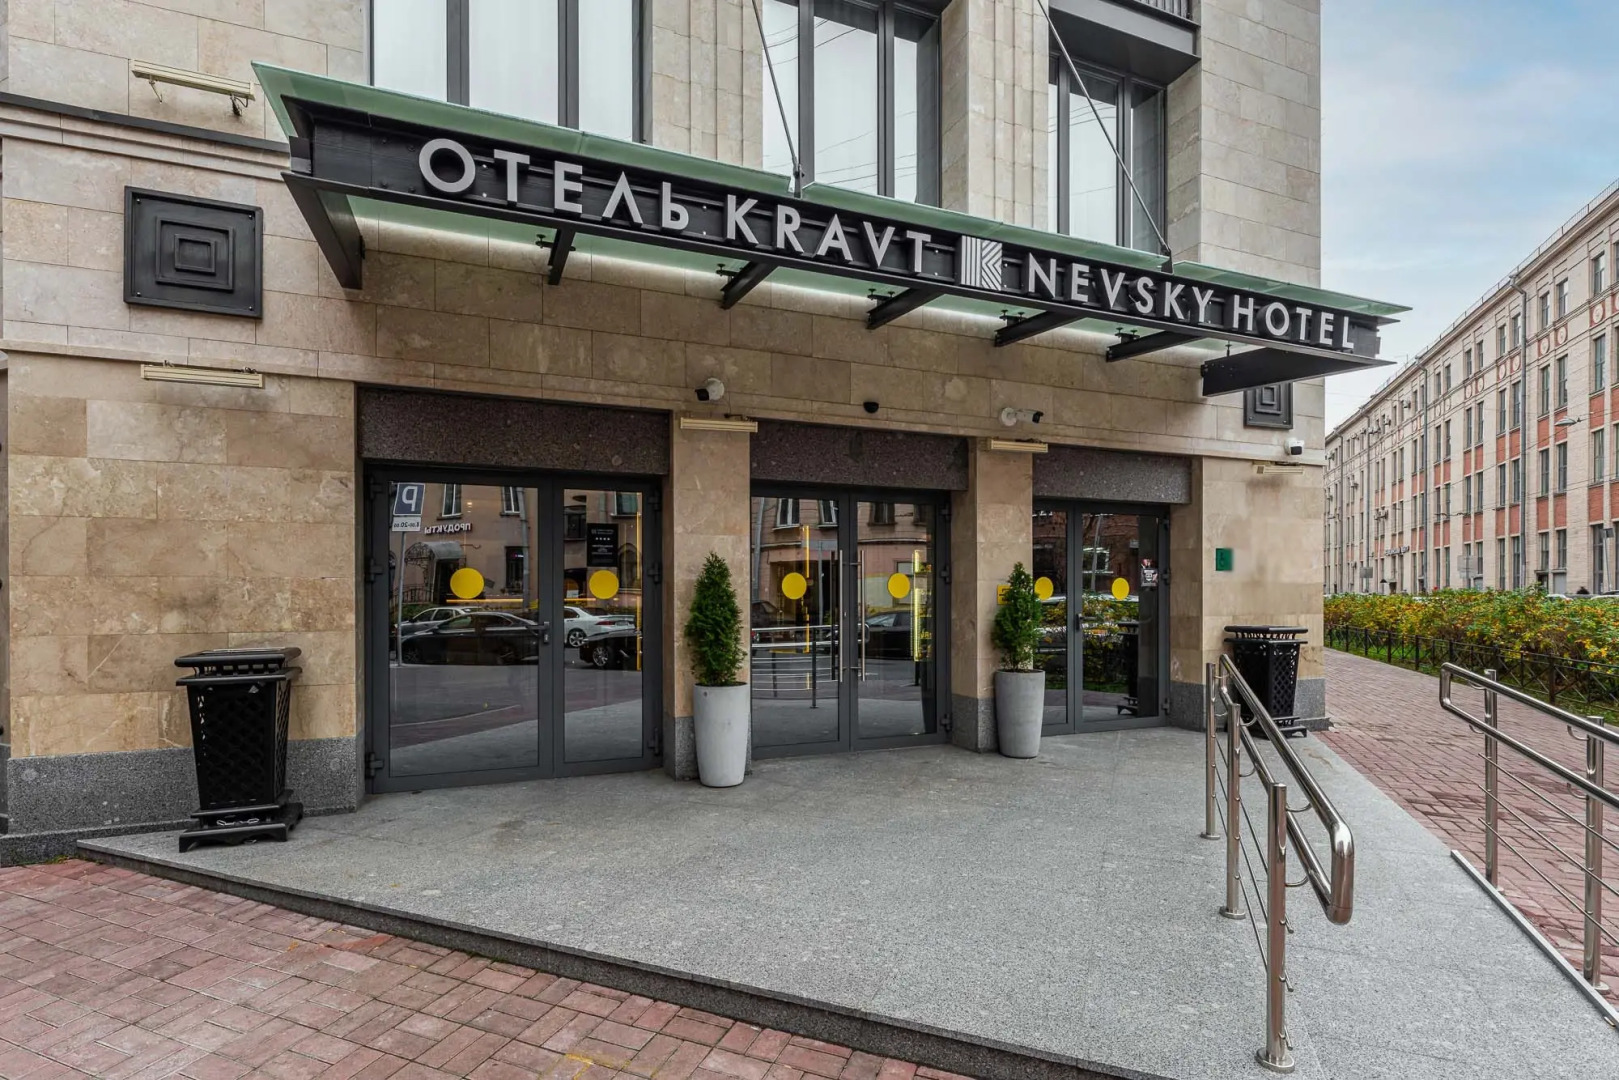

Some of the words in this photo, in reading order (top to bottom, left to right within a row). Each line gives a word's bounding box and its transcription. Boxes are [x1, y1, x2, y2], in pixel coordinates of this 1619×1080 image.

[418, 138, 690, 231] ОТЕЛЬ
[726, 194, 932, 273] KRAVT
[1027, 251, 1215, 323] NEVSKY
[1232, 294, 1355, 349] HOTEL
